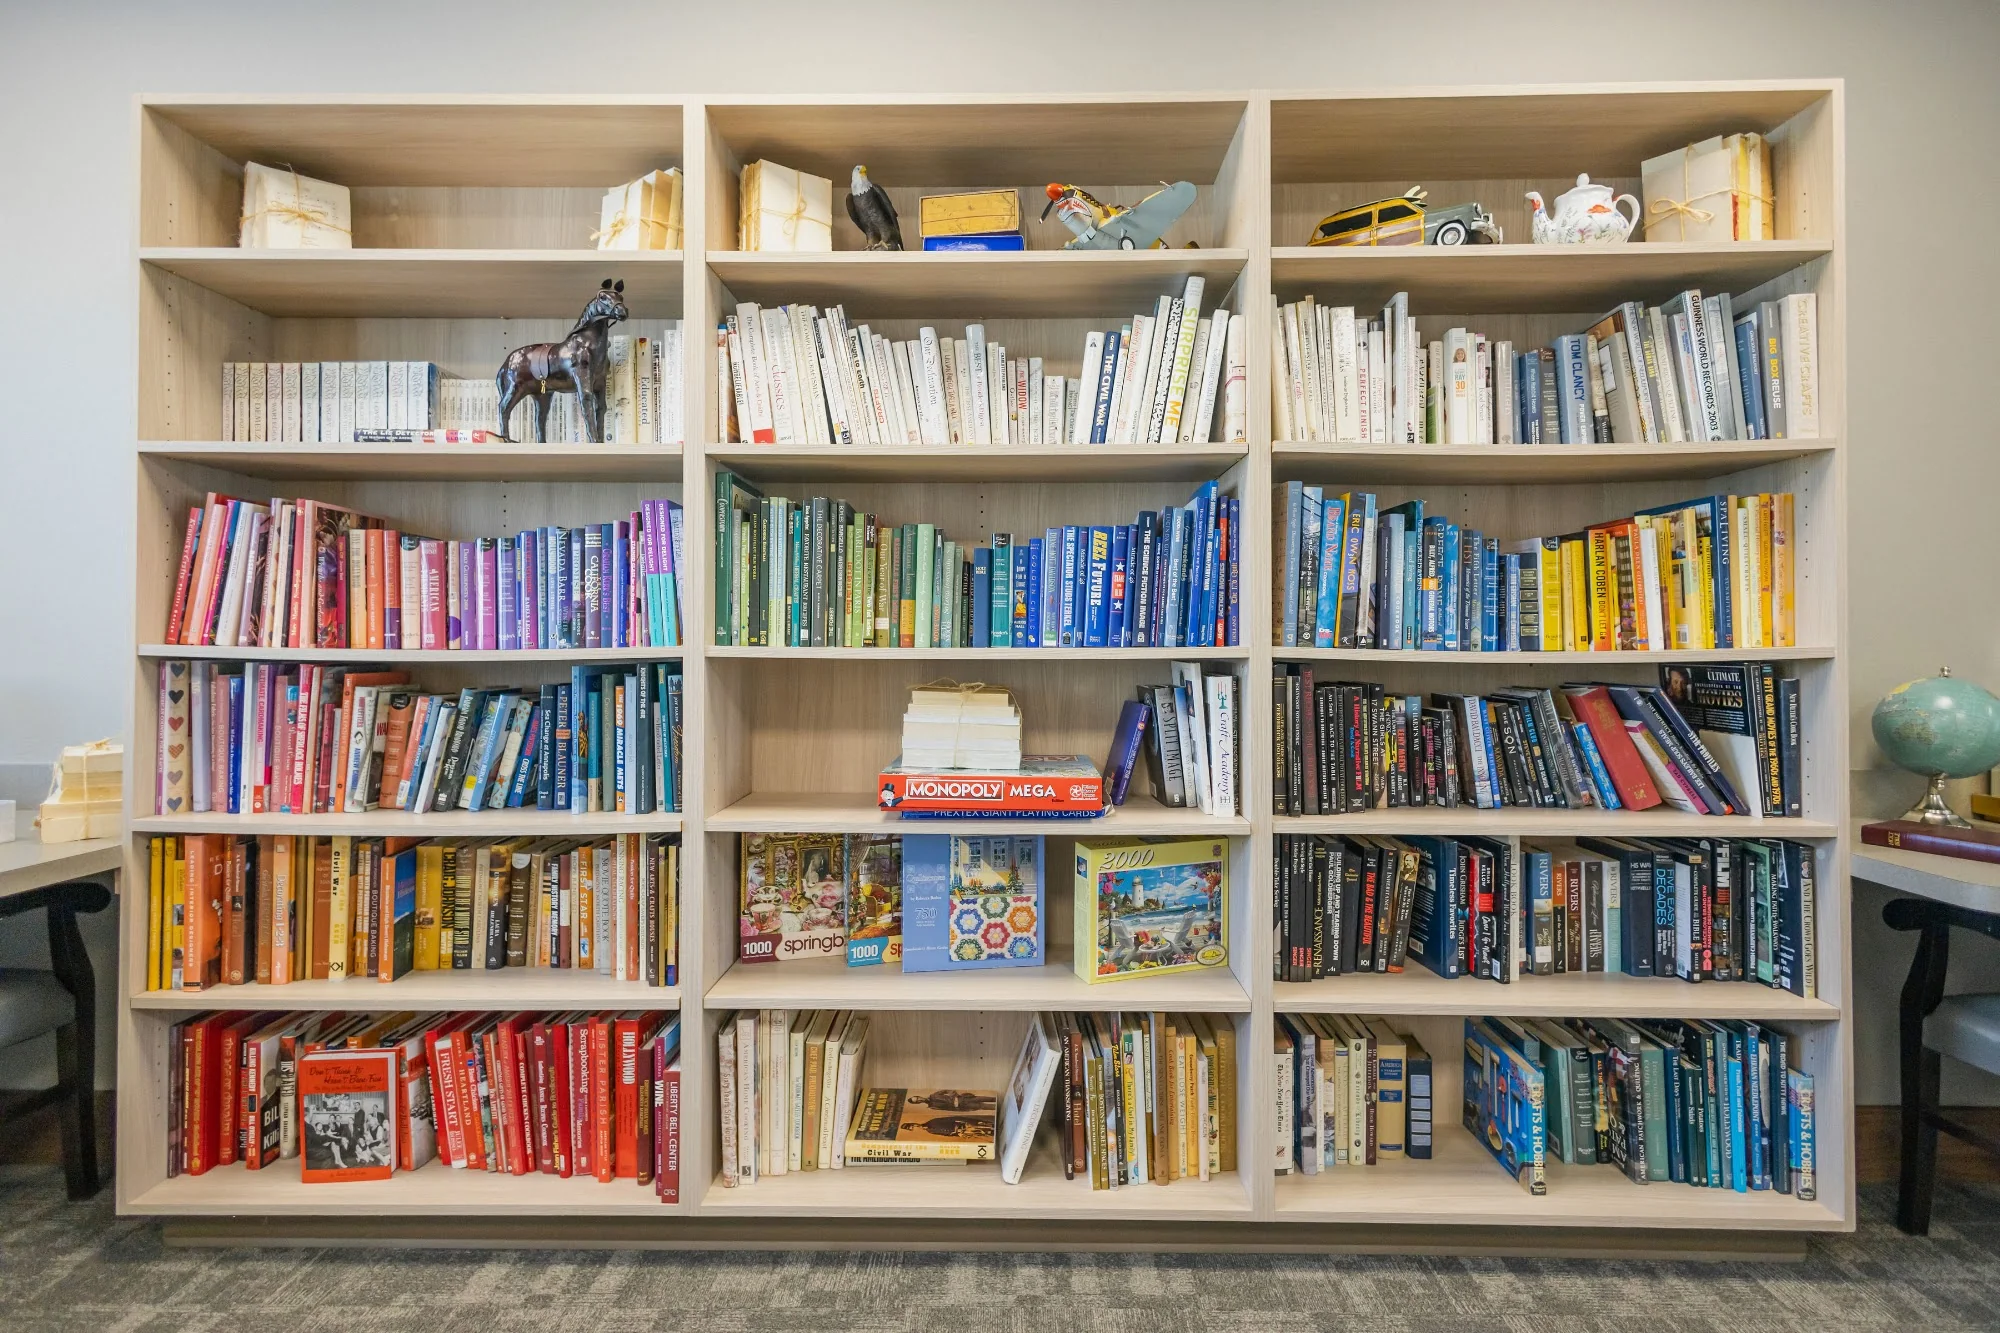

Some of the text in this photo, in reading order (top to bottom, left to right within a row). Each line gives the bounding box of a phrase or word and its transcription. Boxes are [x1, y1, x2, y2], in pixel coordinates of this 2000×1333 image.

[1164, 307, 1198, 428] SURPRISE ME
[1570, 339, 1585, 401] TOM CLANCY
[1690, 295, 1718, 431] GUINNESS WORLD RECORDS 2003
[1768, 338, 1782, 409] BIG BOX REUSE
[641, 377, 650, 425] Educated
[1018, 380, 1027, 409] WIDOW
[1096, 354, 1114, 426] THE CIVIL WAR
[1360, 368, 1368, 406] PERFECT
[1351, 513, 1360, 534] ERIC
[557, 531, 568, 602] NEVADA BARR
[1090, 530, 1107, 606] REEL FUTURE
[1141, 544, 1150, 574] SCIENCE
[1594, 532, 1606, 567] HARLAN
[1346, 569, 1357, 590] MOSS
[1595, 569, 1606, 598] COBEN
[256, 701, 264, 742] CARDMAKING
[541, 721, 551, 743] Change
[1220, 712, 1230, 738] Craft
[1503, 727, 1516, 754] SON
[557, 696, 568, 788] PETER BLAUNER
[1163, 717, 1182, 782] SPLIT IMAGE
[541, 751, 550, 780] Annapolis
[909, 782, 1056, 798] MONOPOLY MEGA
[1100, 849, 1154, 871] 2000
[1367, 872, 1376, 882] THE
[1539, 858, 1549, 896] RIVERS
[1716, 847, 1730, 888] FILM
[441, 852, 456, 929] CRAIG JOHNSON
[1335, 884, 1341, 893] UP
[1365, 902, 1374, 913] THE
[1366, 884, 1375, 896] BAD
[1459, 875, 1467, 905] GRISHAM
[1570, 878, 1579, 911] RIVERS
[1656, 868, 1666, 925] DECADES
[1667, 868, 1675, 927] FIVE EASY
[914, 907, 938, 920] 750
[1362, 914, 1373, 945] BEAUTIFUL
[743, 940, 772, 955] 1000
[784, 933, 844, 960] springb
[851, 944, 879, 959] 1000
[578, 1029, 589, 1094] Scrapbooking
[598, 1030, 607, 1124] SISTER PARISH
[622, 1032, 636, 1084] HOLLYWOOD
[439, 1052, 458, 1126] FRESH START
[459, 1069, 472, 1126] HEARTLAND
[668, 1081, 678, 1171] LIBERTY BELL CENTER
[1073, 1103, 1081, 1126] Hotel
[1532, 1134, 1544, 1182] HOBBIES
[1800, 1142, 1812, 1188] HOBBIES
